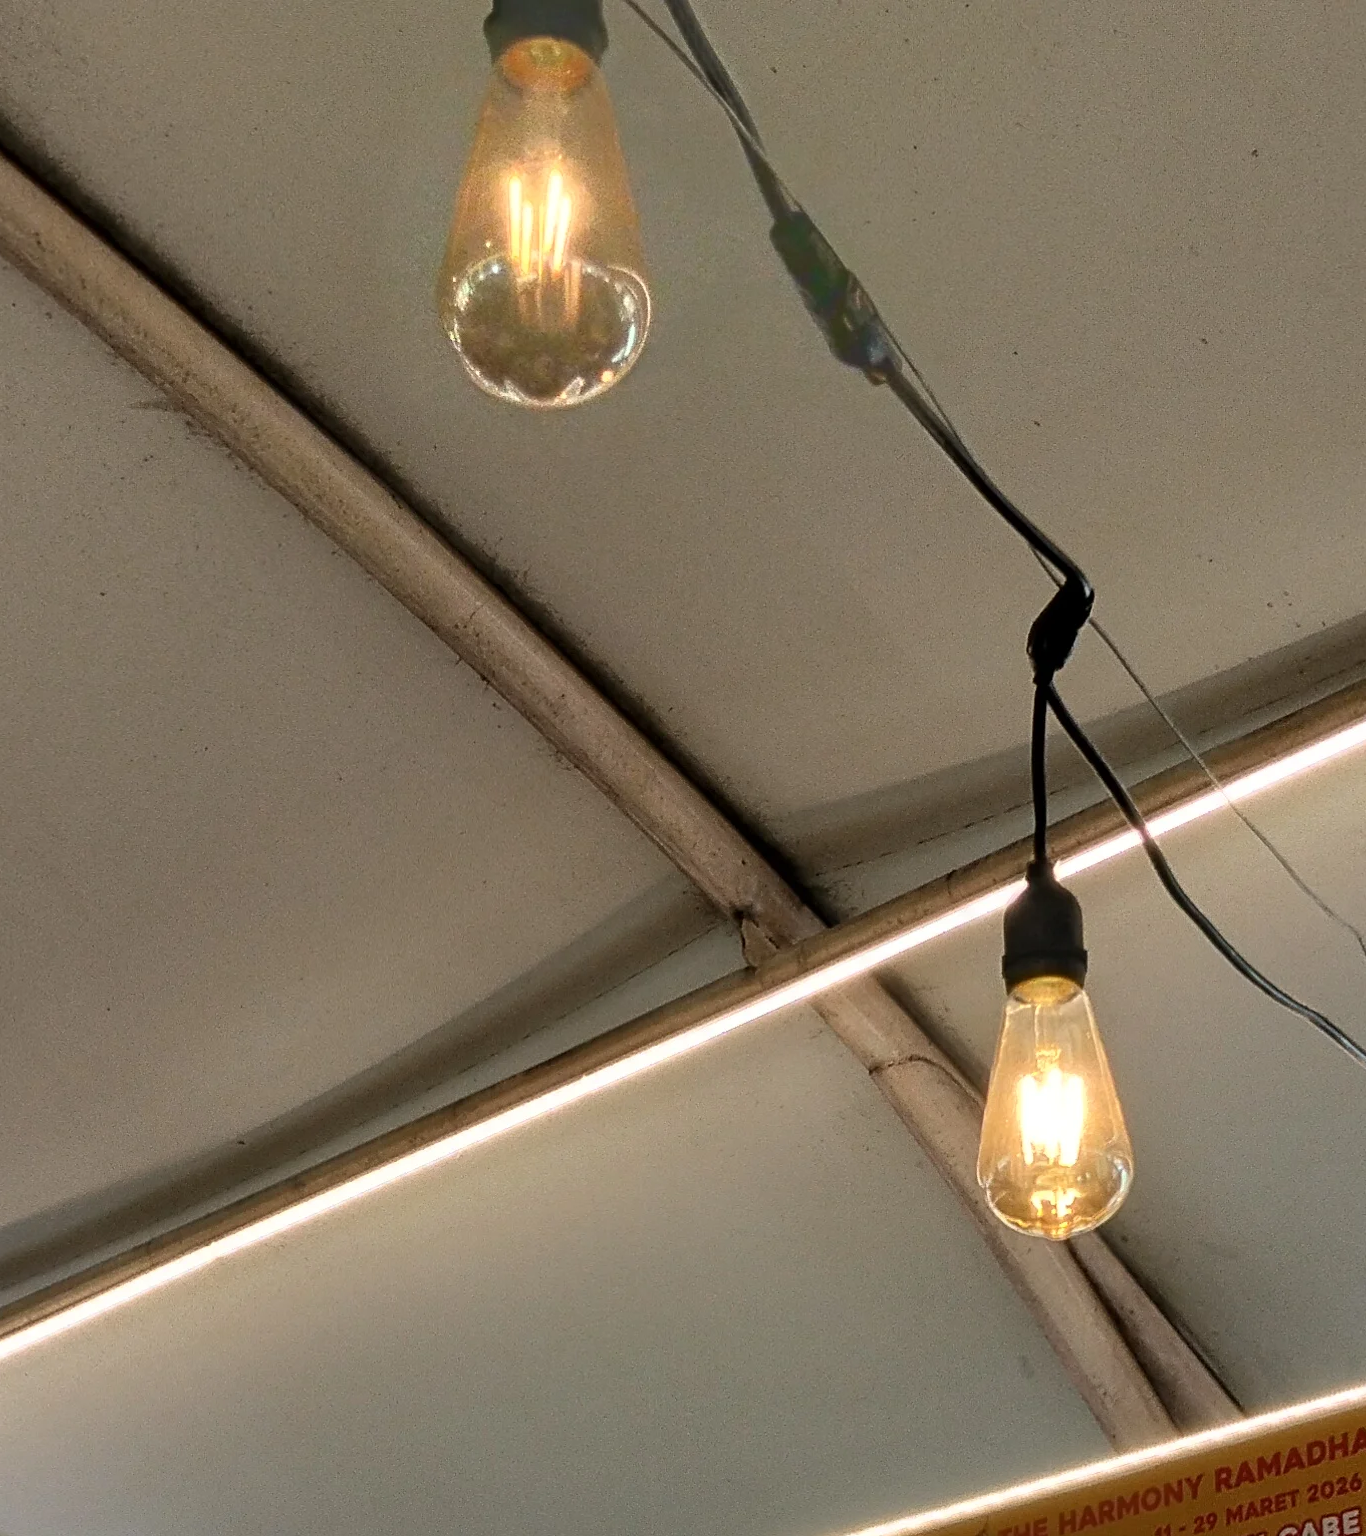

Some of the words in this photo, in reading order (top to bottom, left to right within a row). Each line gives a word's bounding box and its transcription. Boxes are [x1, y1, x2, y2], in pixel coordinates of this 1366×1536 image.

[1058, 1473, 1205, 1536] HARMONY
[1193, 1512, 1218, 1535] 29
[1226, 1488, 1301, 1525] MARET
[1307, 1472, 1363, 1503] 2026
